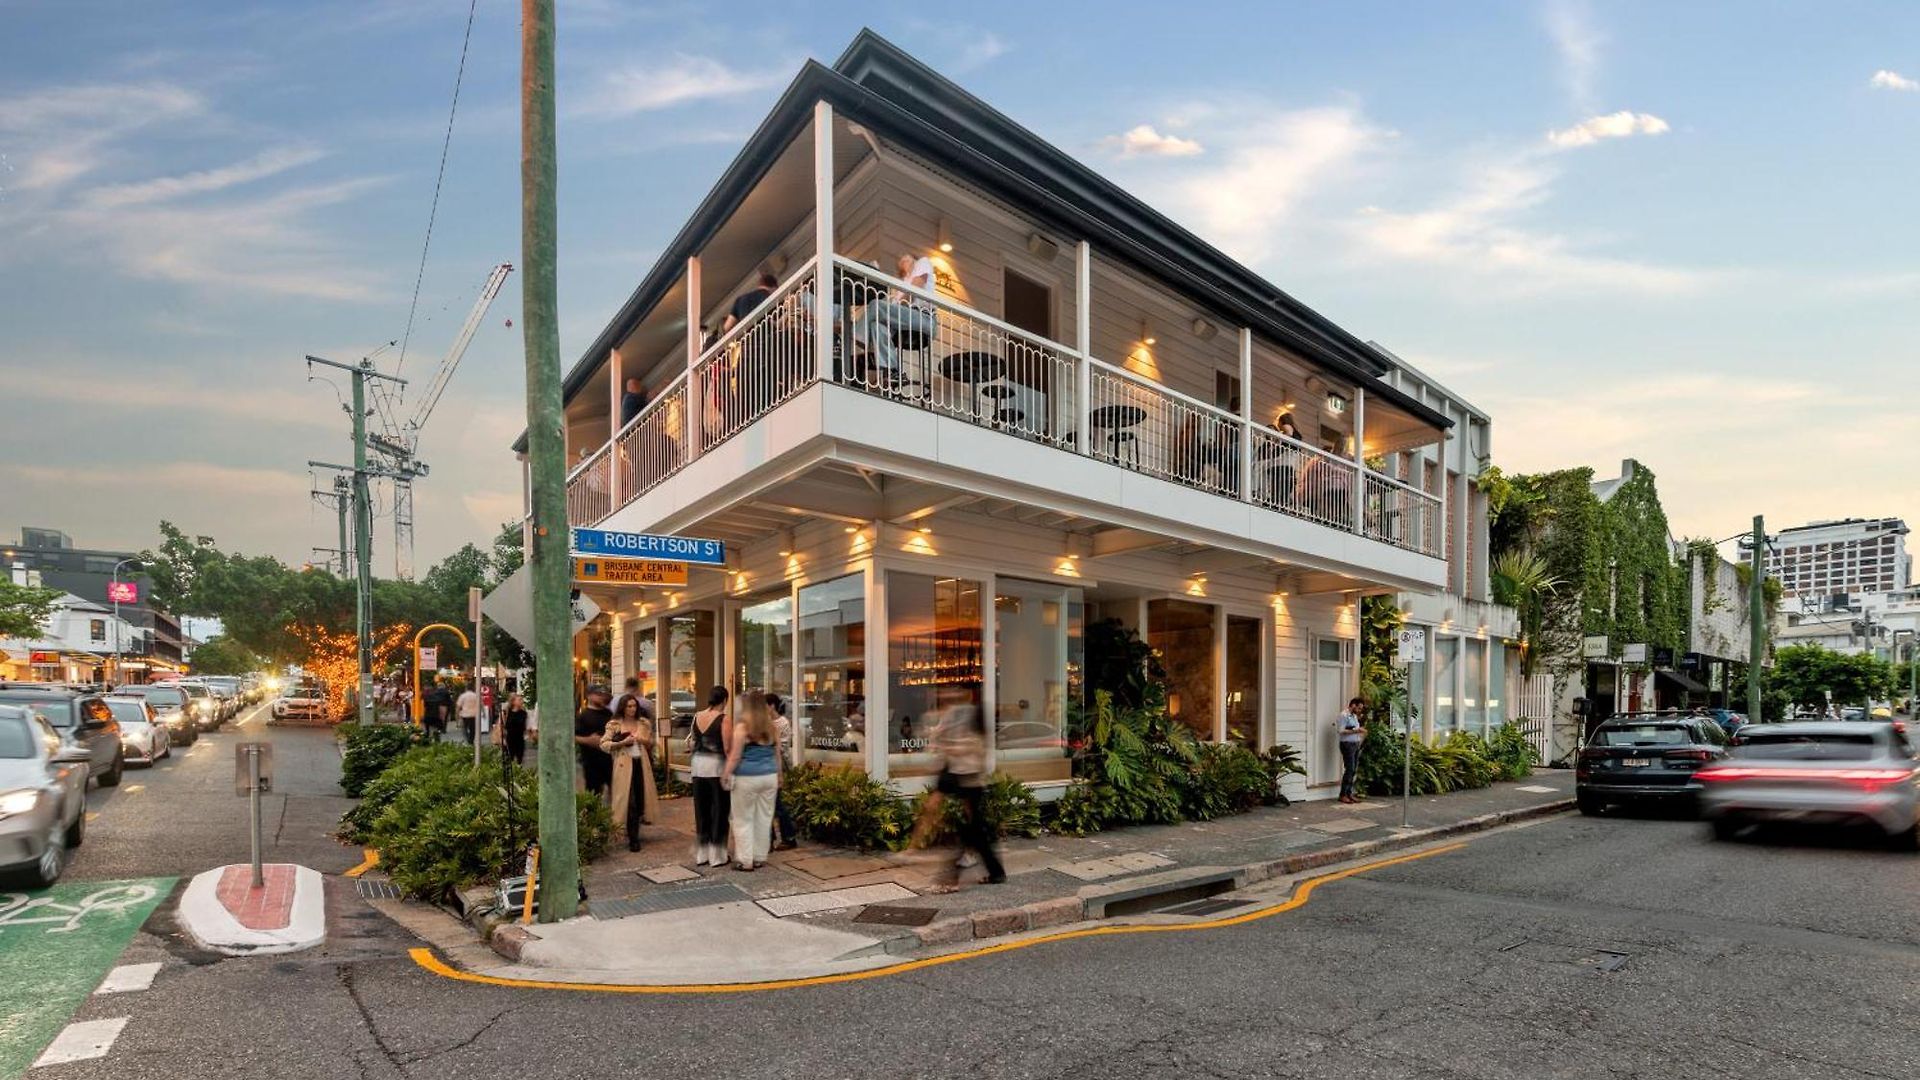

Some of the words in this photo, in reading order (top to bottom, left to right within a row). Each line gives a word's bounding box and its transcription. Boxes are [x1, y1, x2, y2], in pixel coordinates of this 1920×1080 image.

[604, 533, 698, 555] ROBERTSON
[705, 542, 721, 555] ST
[605, 562, 643, 572] BRISBANE
[648, 563, 684, 573] CENTRAL
[605, 572, 637, 581] TRAFFIC
[642, 573, 663, 582] AREA
